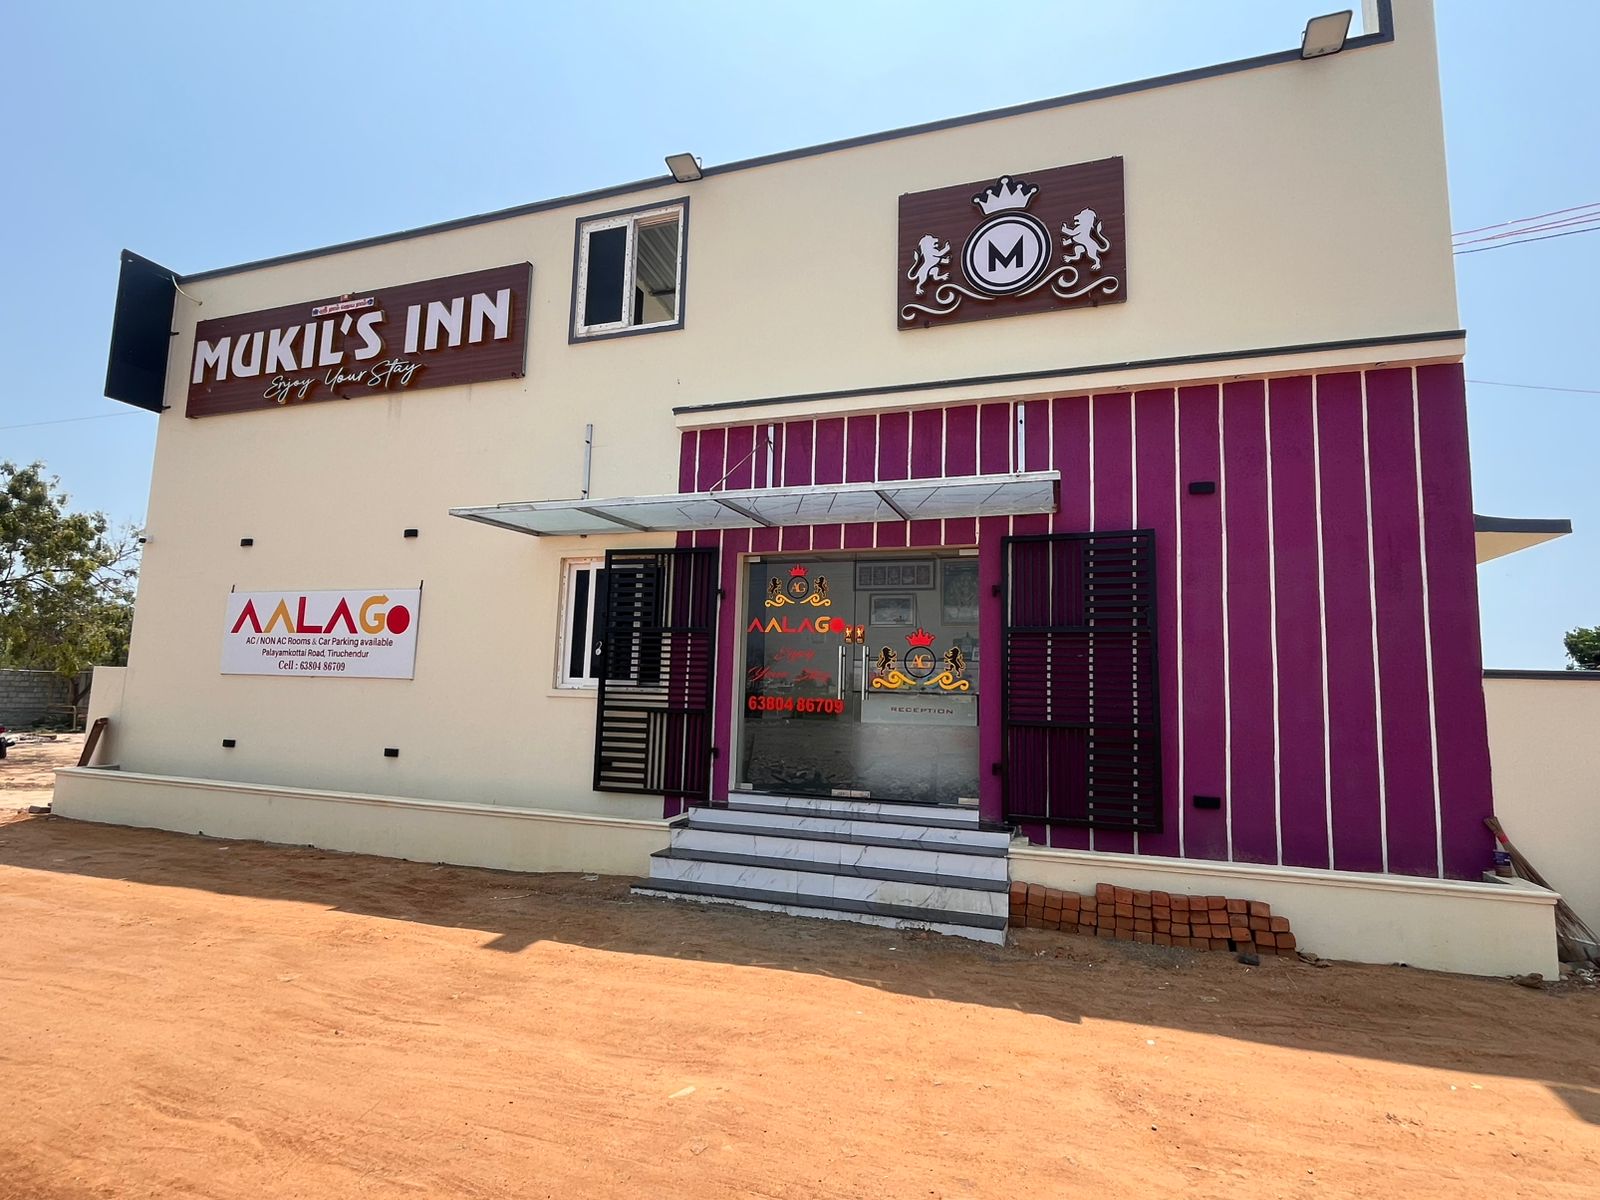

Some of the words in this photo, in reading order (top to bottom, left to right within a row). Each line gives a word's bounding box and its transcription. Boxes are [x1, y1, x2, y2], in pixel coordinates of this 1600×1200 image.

[988, 234, 1024, 272] M
[192, 309, 384, 384] MUKIL'S
[404, 288, 511, 353] INN
[263, 374, 315, 403] Enjoy
[324, 365, 367, 392] Your
[367, 359, 421, 388] Stay
[245, 637, 256, 645] AC
[260, 637, 276, 645] NON
[276, 637, 287, 645] AC
[287, 637, 311, 646] Rooms
[312, 637, 318, 645] &
[318, 637, 331, 646] Car
[331, 637, 359, 648] Parking
[360, 638, 393, 647] available
[262, 649, 307, 658] Palayamkottai
[327, 650, 369, 658] Tiruchendur
[278, 661, 294, 670] Cell
[300, 661, 321, 671] 63804
[323, 661, 345, 672] 86709
[748, 696, 793, 711] 63804
[796, 697, 844, 714] 86709
